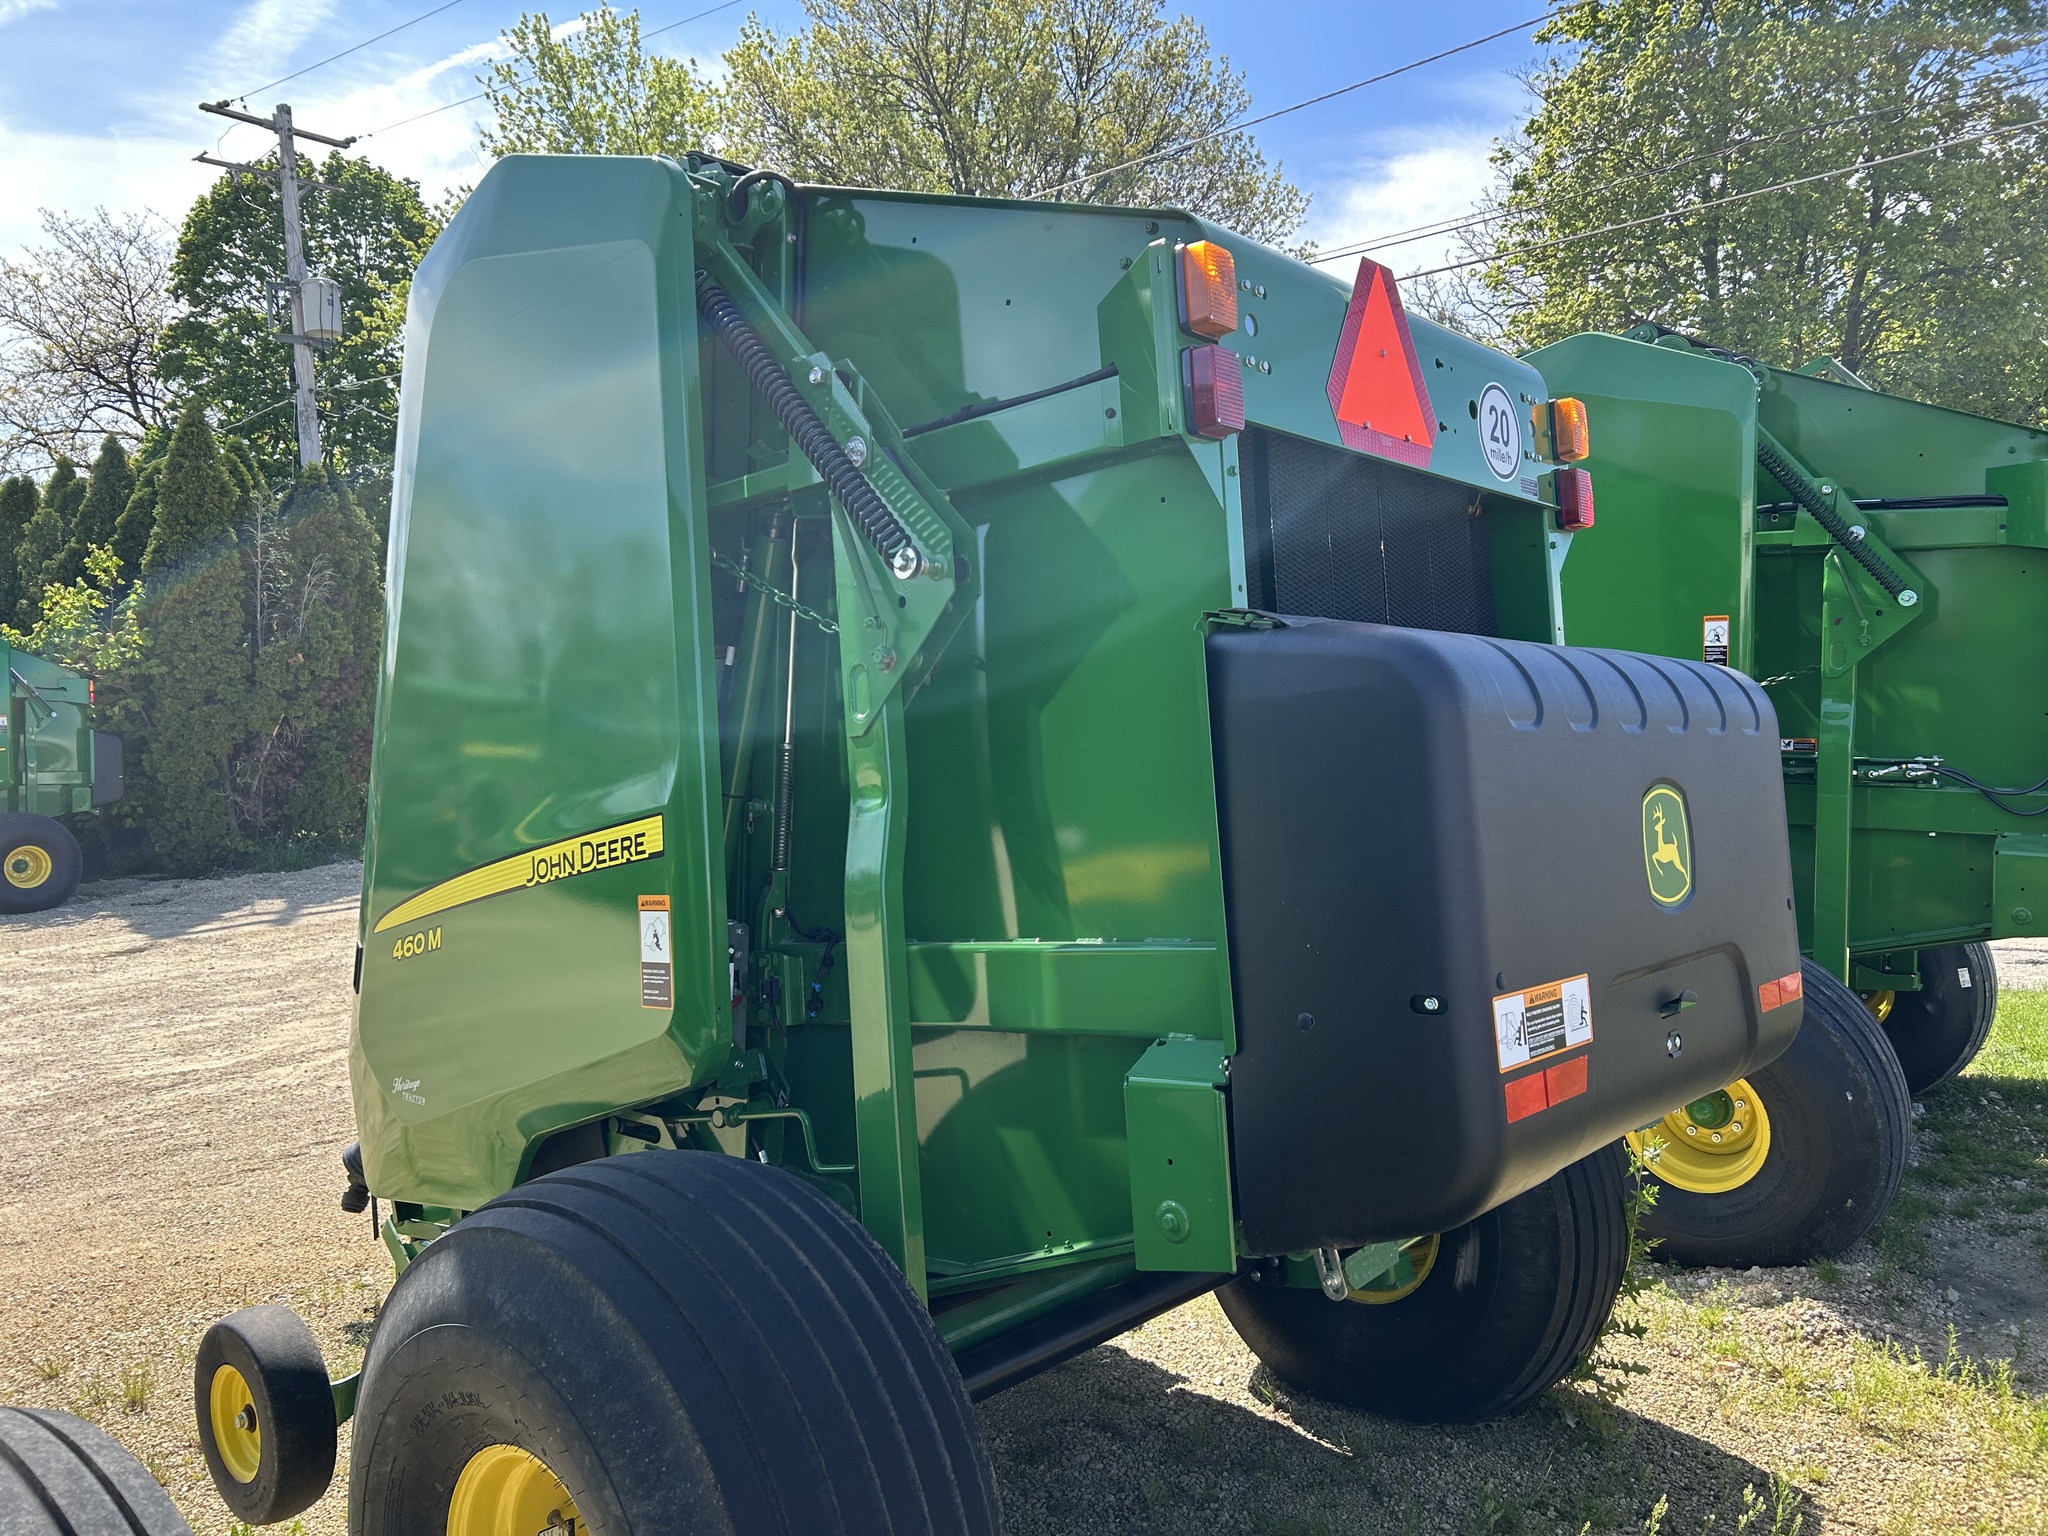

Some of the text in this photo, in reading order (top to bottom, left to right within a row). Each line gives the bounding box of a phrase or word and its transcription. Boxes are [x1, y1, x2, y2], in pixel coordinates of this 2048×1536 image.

[1489, 404, 1510, 448] 20
[1490, 447, 1512, 466] mile/h
[526, 832, 647, 884] JOHN DEERE
[645, 899, 666, 907] WARNING
[392, 925, 442, 961] 460 M
[1534, 988, 1558, 1002] WARNING
[392, 1076, 421, 1094] Heritage
